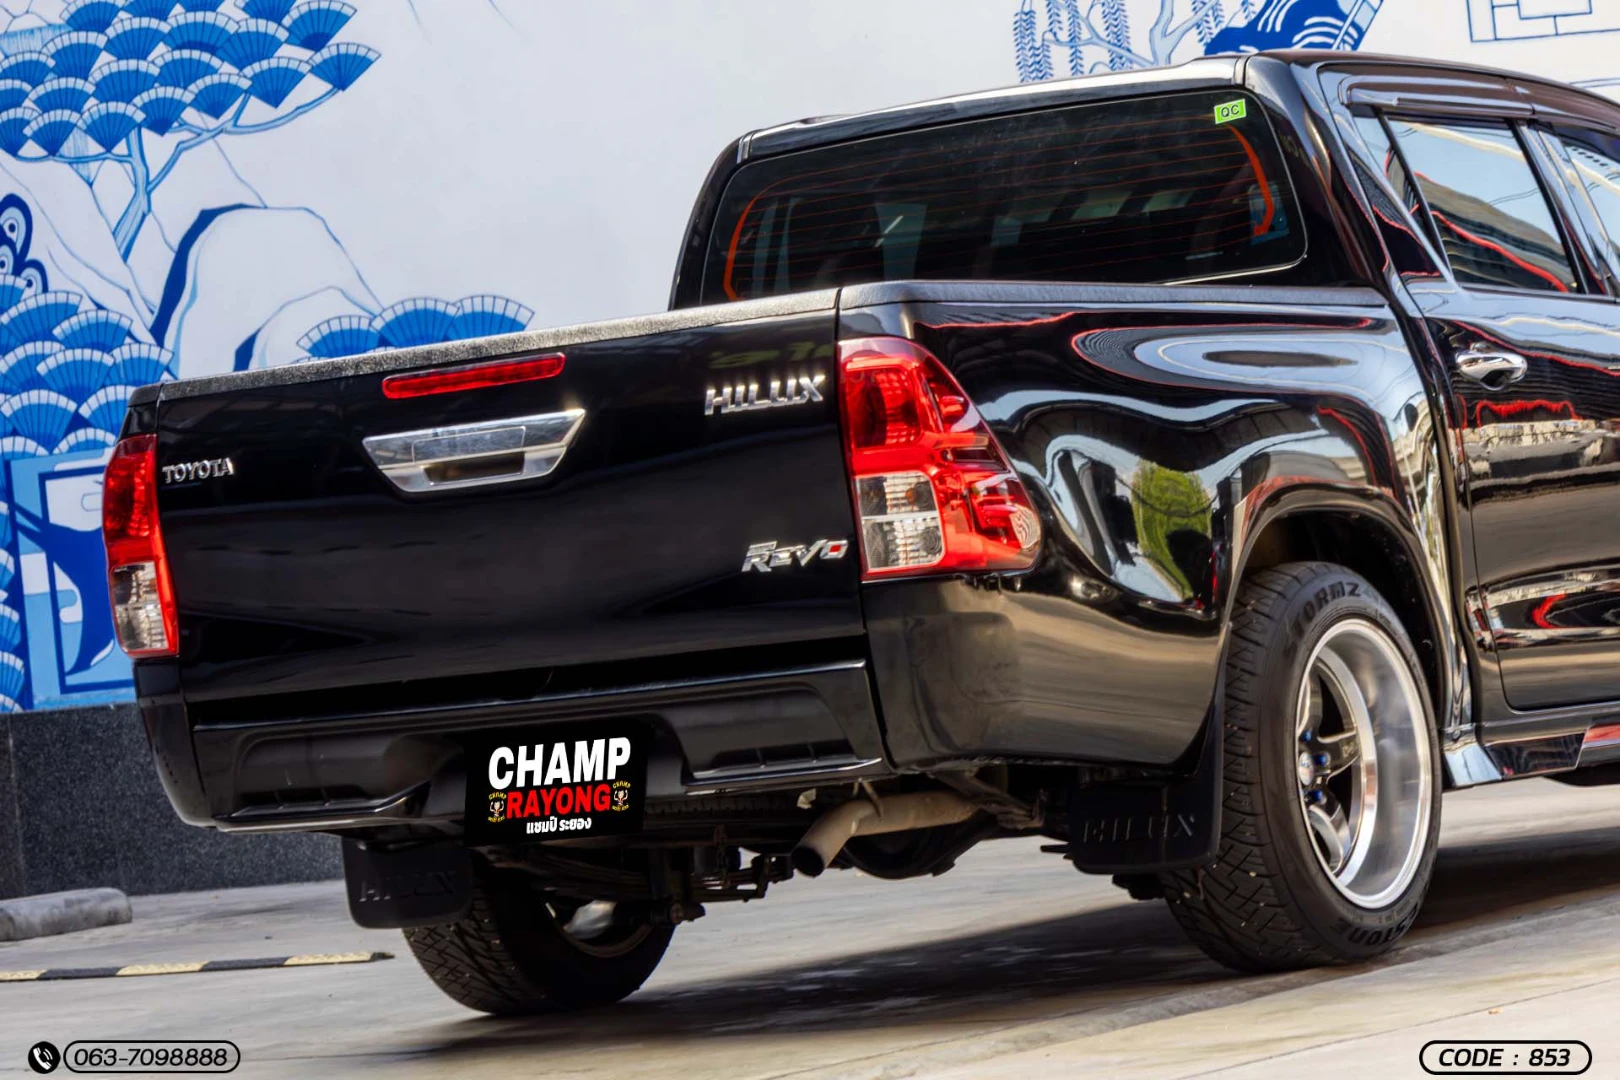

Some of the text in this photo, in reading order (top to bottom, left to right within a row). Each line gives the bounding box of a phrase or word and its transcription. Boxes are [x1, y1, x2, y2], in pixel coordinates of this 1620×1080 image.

[1221, 104, 1240, 118] QC
[704, 374, 826, 416] HILUX
[162, 457, 235, 484] TOYOTA
